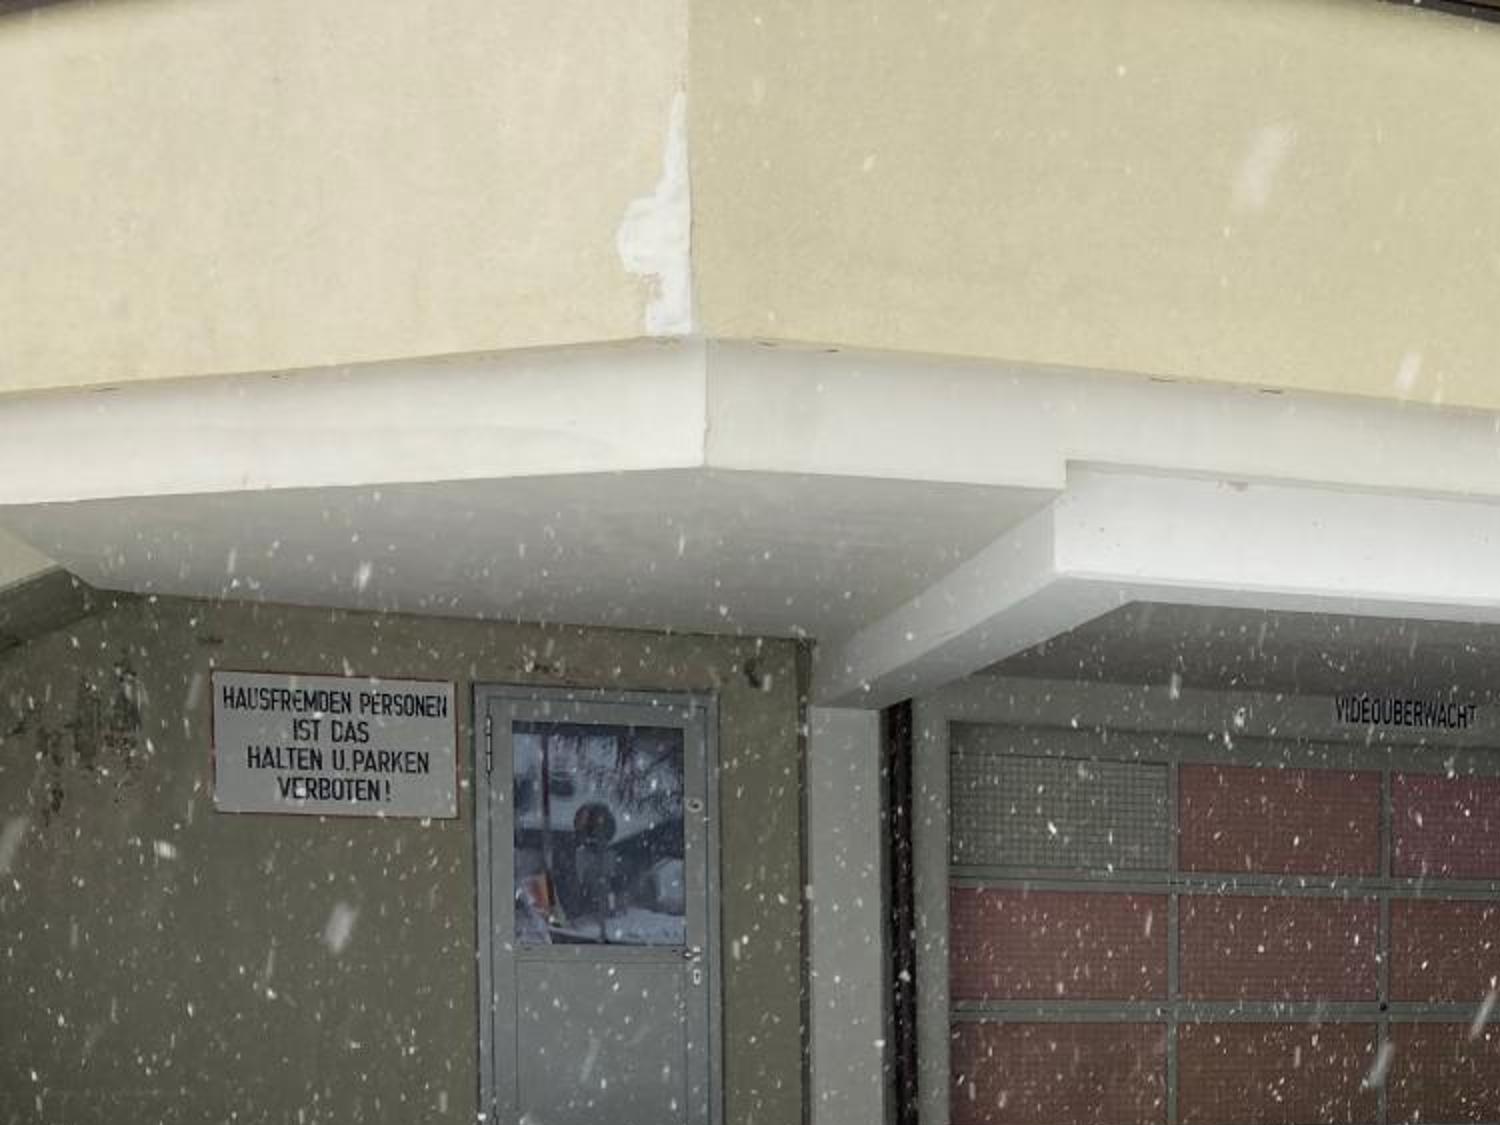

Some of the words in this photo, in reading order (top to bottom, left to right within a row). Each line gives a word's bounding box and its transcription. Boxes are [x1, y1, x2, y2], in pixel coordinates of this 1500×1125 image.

[223, 685, 350, 714] HAUSFREMDEN
[360, 693, 447, 718] PERSONEN
[293, 719, 320, 741] IST
[331, 721, 369, 743] DAS
[247, 746, 322, 770] HALTEN
